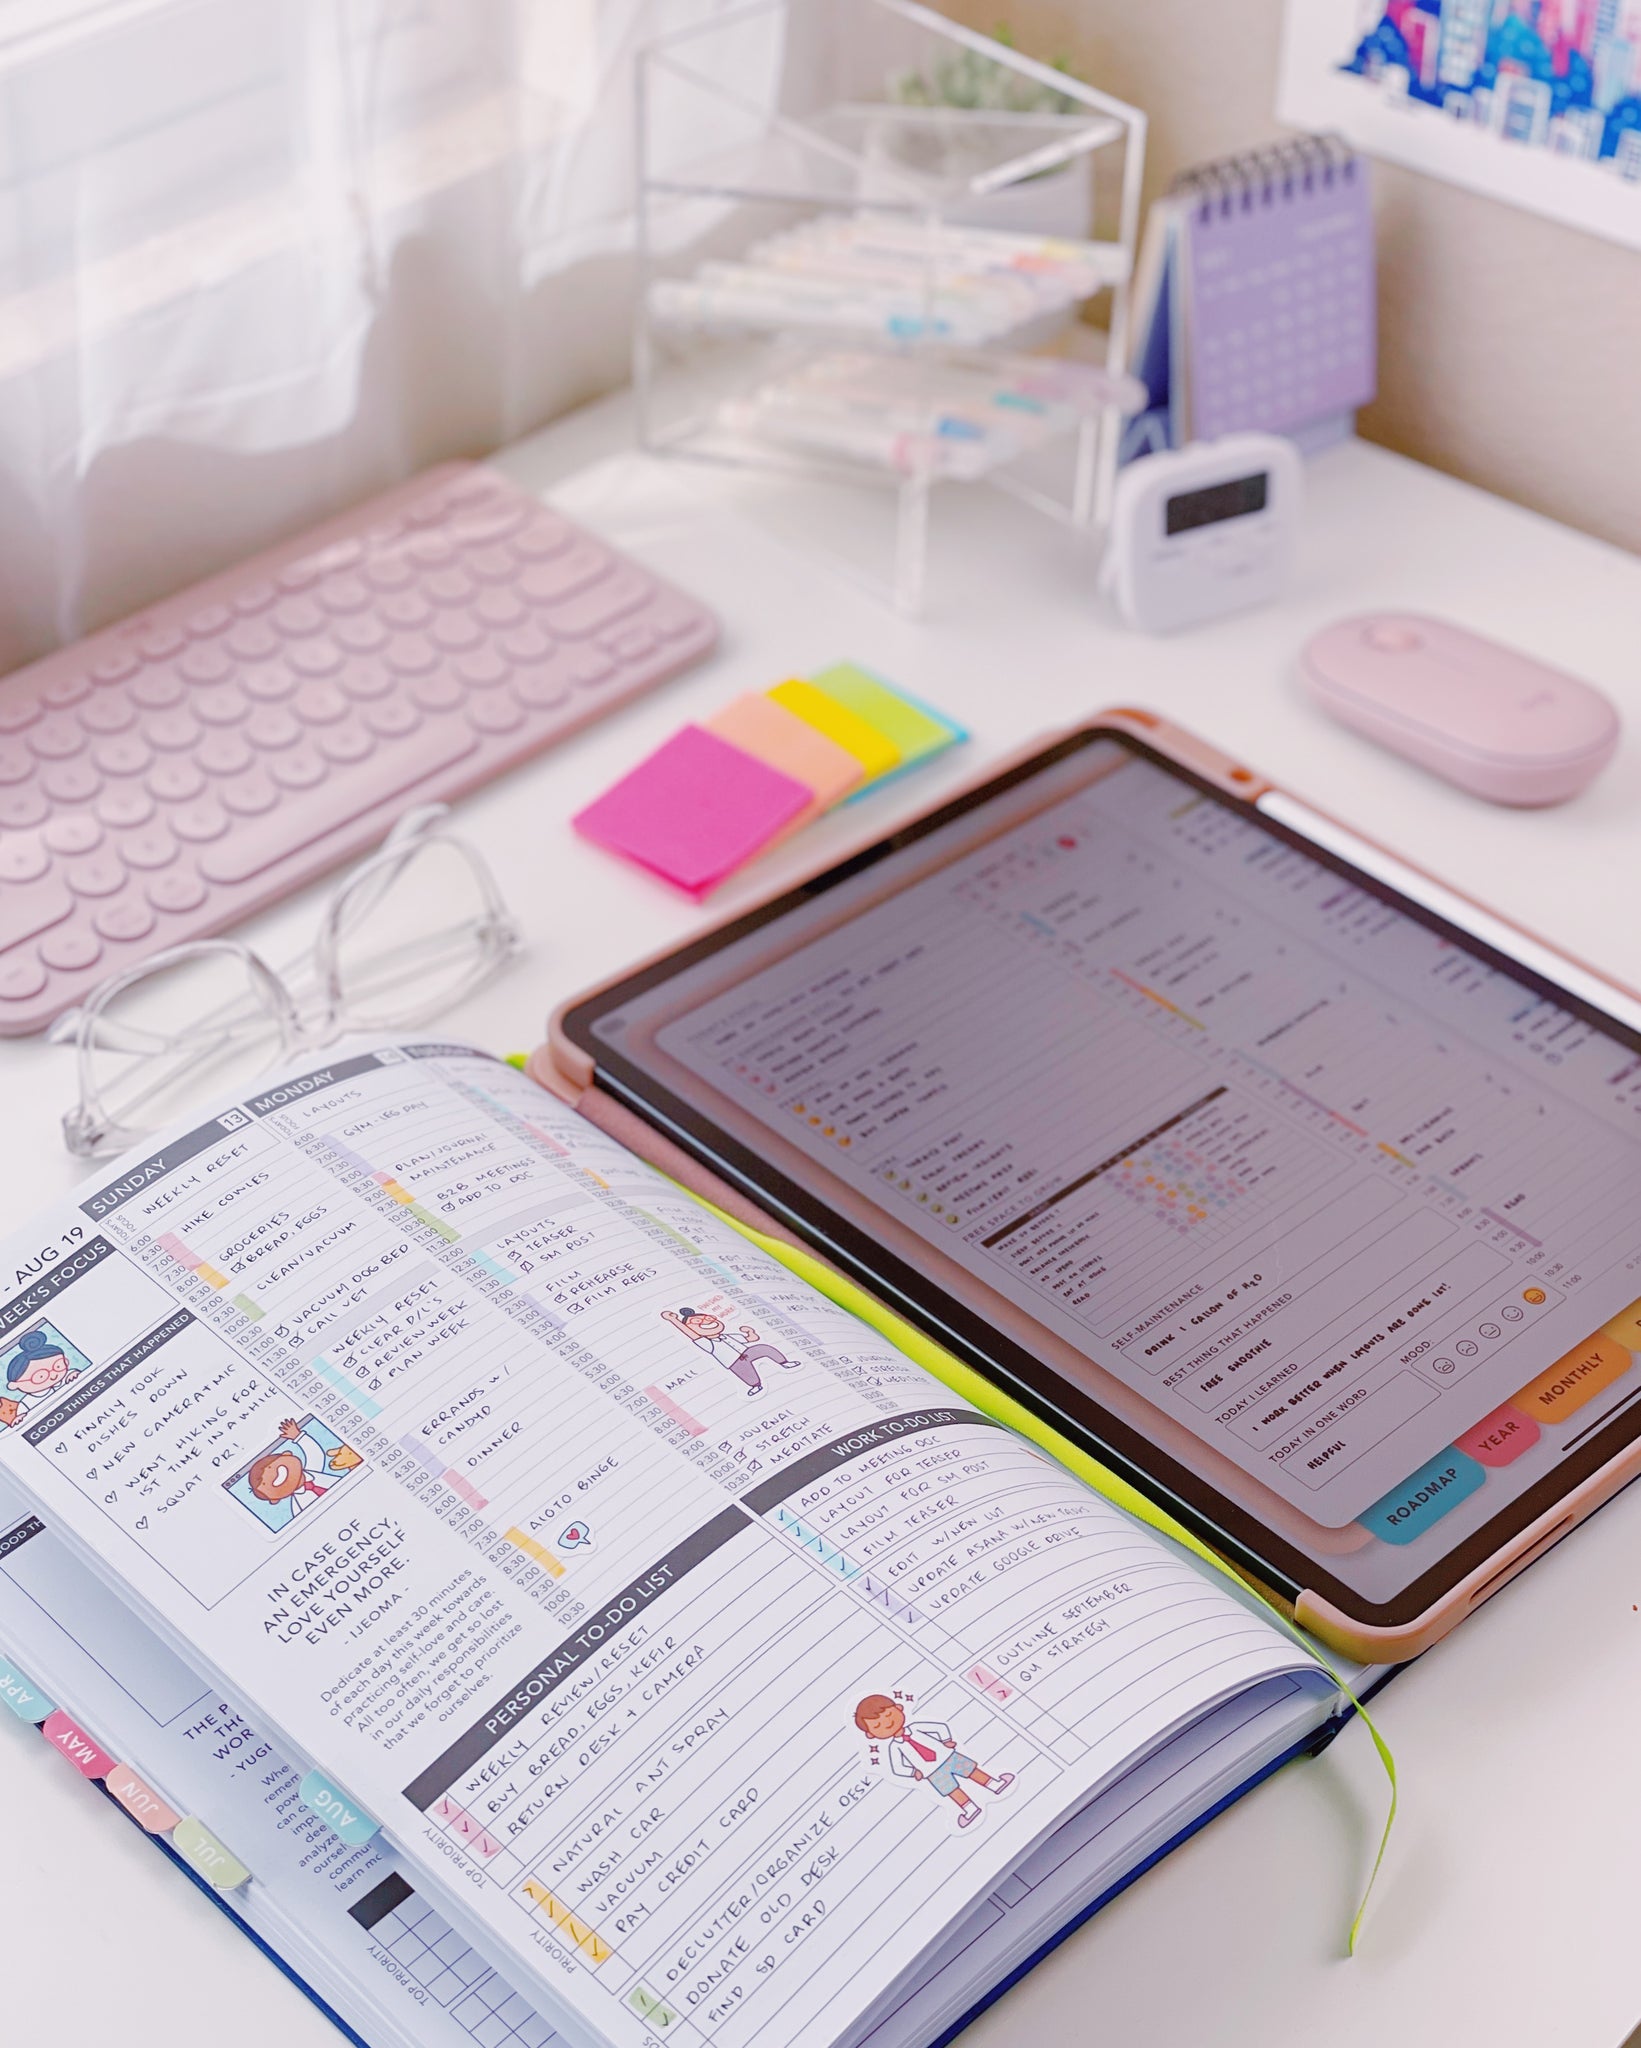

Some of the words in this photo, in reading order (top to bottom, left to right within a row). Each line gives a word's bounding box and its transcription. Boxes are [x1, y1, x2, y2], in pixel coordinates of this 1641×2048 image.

[254, 1071, 334, 1112] MONDAY
[303, 1090, 362, 1118] LAYOUTS
[92, 1158, 167, 1214] SUNDAY
[224, 1114, 243, 1127] 13
[142, 1175, 200, 1215] WEEKLY
[207, 1144, 249, 1173] RESET
[409, 1143, 496, 1181] MAINTENANCE
[437, 1183, 468, 1200] B2B
[476, 1157, 536, 1182] MEETINGS
[458, 1191, 482, 1205] ADD
[487, 1184, 501, 1195] TO
[510, 1171, 535, 1183] DOC
[181, 1210, 214, 1233] HIKE
[220, 1211, 290, 1262] GROCERIES
[296, 1205, 327, 1229] EGGS
[497, 1219, 556, 1248] LAYOUTS
[526, 1225, 577, 1251] TEASER
[15, 1246, 59, 1284] AUG
[62, 1226, 84, 1245] 19
[51, 1242, 107, 1286] FOCUS
[540, 1250, 561, 1262] SM
[566, 1232, 595, 1249] POST
[1526, 1251, 1545, 1266] 10:00
[293, 1283, 349, 1324] VACUUM
[352, 1266, 379, 1284] DOG
[381, 1244, 409, 1265] BED
[546, 1271, 581, 1291] FILM
[570, 1263, 634, 1295] REHEARSE
[584, 1287, 617, 1306] FILM
[622, 1268, 657, 1286] REELS
[1562, 1274, 1582, 1289] 11:00
[308, 1313, 338, 1334] CALL
[343, 1287, 368, 1307] VET
[332, 1315, 389, 1354] WEEKLY
[395, 1281, 438, 1311] RESET
[375, 1330, 425, 1368] REVIEW
[427, 1300, 468, 1328] WEEK
[1111, 1284, 1204, 1351] SELF-MAINTENANCE
[1144, 1334, 1175, 1356] DRINK
[1191, 1301, 1223, 1325] GALLON
[1227, 1289, 1239, 1300] OF
[360, 1326, 401, 1355] CLEAR
[389, 1351, 423, 1377] PLAN
[428, 1318, 469, 1347] WEEK
[1163, 1368, 1188, 1387] BEST
[1187, 1345, 1219, 1370] THING
[1218, 1327, 1244, 1347] THAT
[1245, 1293, 1293, 1329] HAPPENED
[1200, 1374, 1223, 1392] FREE
[1228, 1339, 1272, 1372] SMOOTHIE
[29, 1412, 65, 1441] GOOD
[65, 1381, 106, 1412] THINGS
[105, 1357, 132, 1384] THAT
[133, 1314, 189, 1358] HAPPENED
[666, 1370, 698, 1390] MALL
[1215, 1399, 1249, 1425] TODAY
[1256, 1363, 1298, 1396] LEARNED
[1538, 1353, 1604, 1405] MONTHLY
[74, 1400, 126, 1440] FINALLY
[131, 1367, 164, 1396] TOOK
[88, 1410, 138, 1453] DISHES
[149, 1369, 188, 1403] DOWN
[168, 1446, 202, 1472] TIME
[208, 1431, 224, 1445] IN
[227, 1421, 236, 1430] A
[240, 1386, 278, 1420] WHILE
[422, 1387, 485, 1436] ERRANDS
[738, 1409, 795, 1441] JOURNAL
[1261, 1406, 1289, 1426] WORK
[1268, 1437, 1303, 1462] TODAY
[1303, 1428, 1315, 1438] IN
[1315, 1410, 1338, 1429] ONE
[1337, 1388, 1367, 1412] WORD
[125, 1455, 167, 1488] WENT
[175, 1406, 228, 1449] HIKING
[232, 1380, 260, 1403] FOR
[367, 1437, 389, 1457] 3:30
[468, 1422, 523, 1467] DINNER
[756, 1418, 810, 1450] STRETCH
[770, 1423, 833, 1464] MEDITATE
[831, 1432, 883, 1457] WORK
[879, 1416, 931, 1436] TO-DO
[932, 1413, 956, 1423] LIST
[1307, 1440, 1346, 1470] HELPFUL
[1478, 1421, 1521, 1452] YEAR
[157, 1474, 203, 1513] SQUAT
[212, 1443, 244, 1467] PR!
[577, 1456, 619, 1490] BINGE
[819, 1486, 874, 1523] LAYOUT
[885, 1467, 910, 1485] FOR
[917, 1448, 961, 1469] TEASER
[1387, 1468, 1458, 1526] ROADMAP
[864, 1531, 898, 1555] FILM
[904, 1495, 959, 1527] TEASER
[263, 1608, 289, 1633] AN
[290, 1518, 398, 1608] EMERGENCY,
[268, 1583, 289, 1602] IN
[292, 1543, 337, 1581] CASE
[338, 1519, 362, 1542] OF
[908, 1554, 958, 1593] UPDATE
[966, 1530, 1008, 1557] ASANA
[929, 1571, 986, 1609] UPDATE
[993, 1540, 1040, 1572] GOOGLE
[1045, 1526, 1083, 1544] DRIVE
[278, 1602, 324, 1644] LOVE
[324, 1529, 406, 1602] YOURSELF
[305, 1603, 352, 1645] EVEN
[354, 1558, 409, 1602] MORE.
[320, 1656, 373, 1703] Dedicate
[374, 1645, 384, 1657] at
[383, 1620, 413, 1644] least
[412, 1605, 428, 1621] 30
[429, 1569, 472, 1608] minutes
[350, 1593, 402, 1638] IJEOMA
[997, 1622, 1058, 1665] OUTLINE
[1062, 1583, 1133, 1619] SEPTEMBER
[1048, 1619, 1111, 1658] STRATEGY
[343, 1675, 400, 1726] practicing
[399, 1633, 445, 1674] self-love
[447, 1611, 467, 1633] and
[469, 1590, 495, 1613] care.
[484, 1649, 579, 1735] PERSONAL
[575, 1597, 637, 1648] TO-DO
[636, 1565, 674, 1597] LIST
[438, 1674, 493, 1722] ourselves.
[466, 1740, 529, 1792] WEEKLY
[541, 1625, 650, 1725] REVIEW/RESET
[57, 1730, 97, 1764] MAY
[488, 1783, 518, 1813] BUY
[529, 1725, 586, 1776] BREAD,
[587, 1683, 631, 1719] EGGS,
[631, 1636, 677, 1678] KEFIR
[121, 1782, 159, 1814] JUN
[315, 1789, 357, 1826] AUG
[553, 1808, 623, 1872] NATURAL
[636, 1758, 670, 1793] ANT
[672, 1708, 730, 1753] SPRAY
[194, 1838, 225, 1866] JUL
[577, 1851, 622, 1893] WASH
[631, 1807, 665, 1839] CAR
[686, 1935, 750, 2005] DONATE
[761, 1893, 792, 1923] OLD
[801, 1846, 840, 1886] DESK
